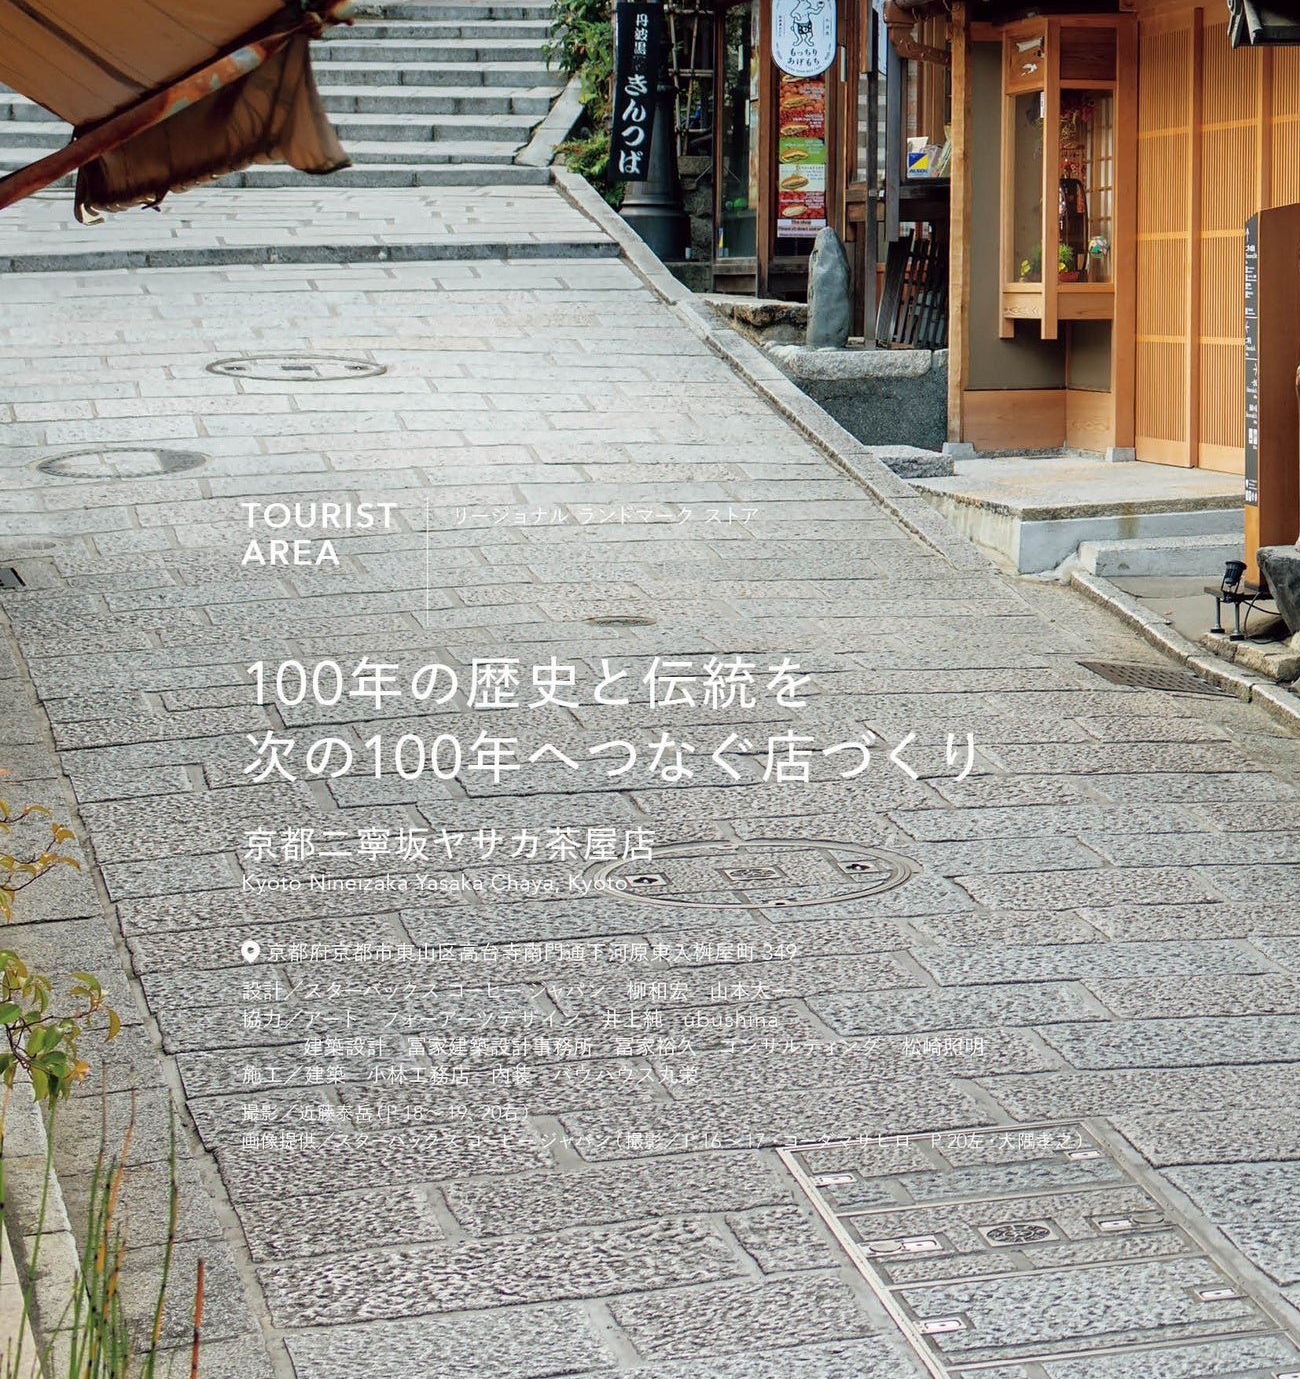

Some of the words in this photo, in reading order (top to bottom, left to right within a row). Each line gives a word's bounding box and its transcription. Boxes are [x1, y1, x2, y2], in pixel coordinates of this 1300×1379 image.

[790, 48, 818, 57] もっちり
[787, 57, 820, 67] あげもち
[618, 74, 648, 175] きんつば
